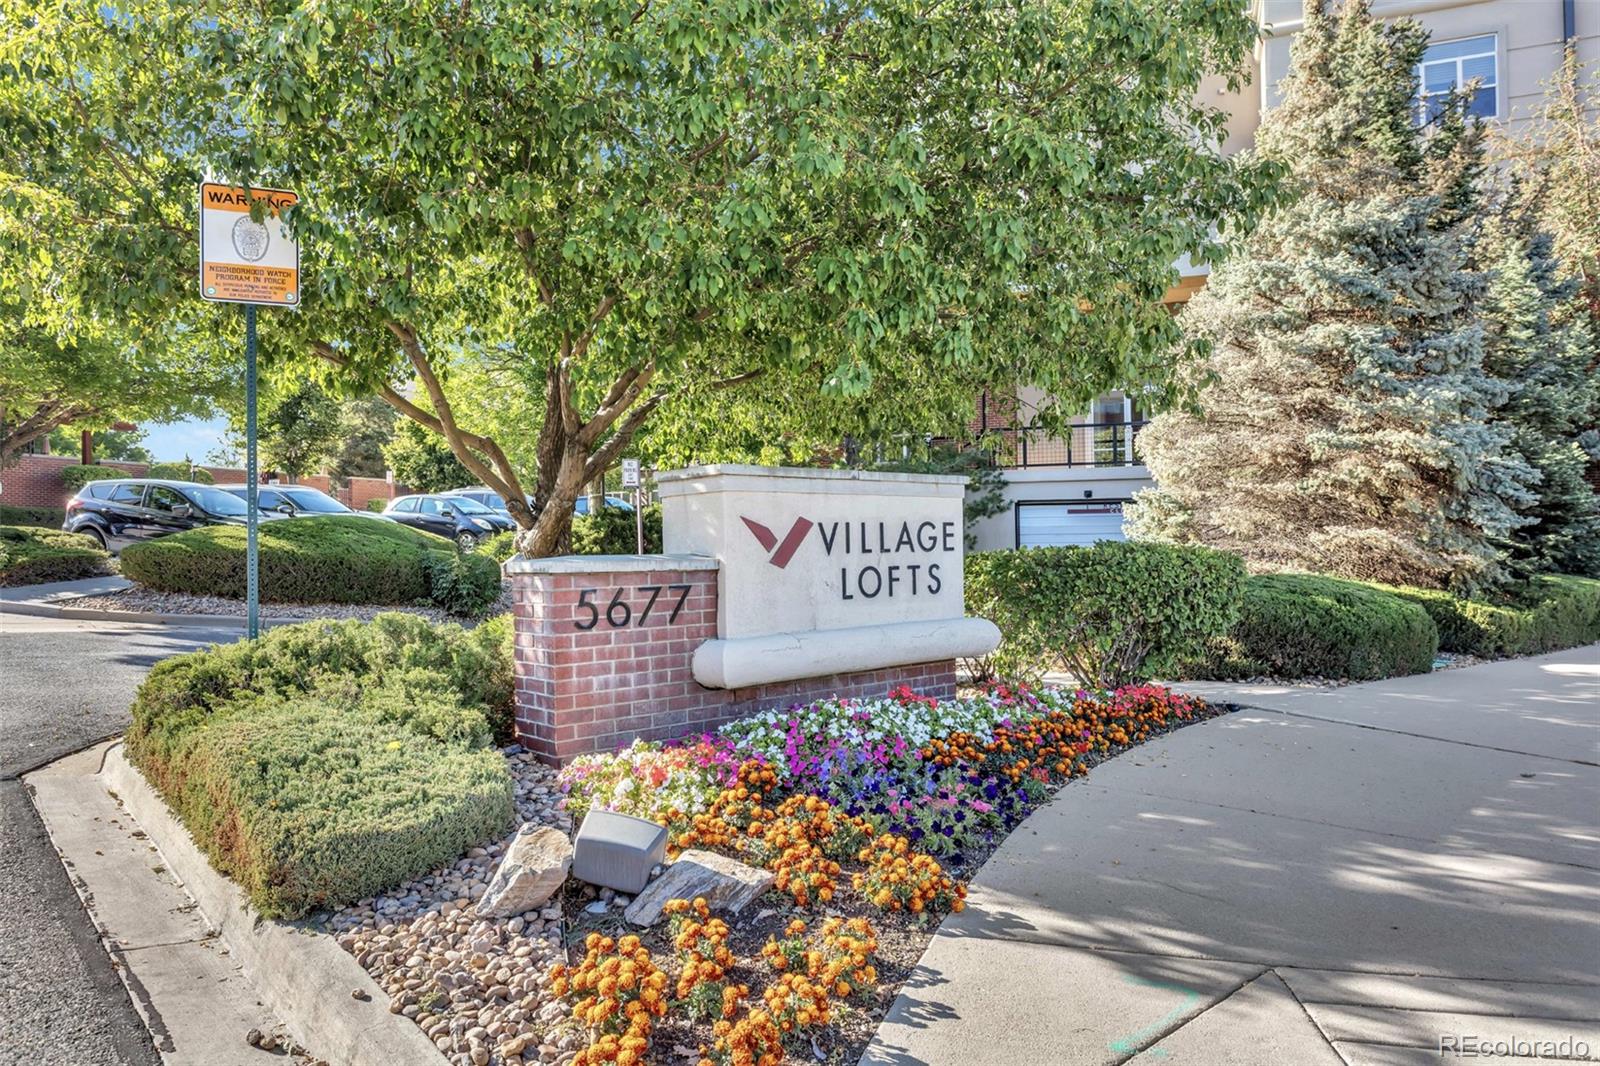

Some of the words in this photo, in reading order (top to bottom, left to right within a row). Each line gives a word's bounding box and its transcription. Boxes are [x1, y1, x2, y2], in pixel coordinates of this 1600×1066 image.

[208, 191, 293, 211] WARNG
[215, 273, 250, 282] PROGRAM
[264, 277, 286, 285] FORCE
[267, 269, 291, 278] WATCH
[818, 521, 955, 556] VILLAGE
[842, 563, 941, 600] LOFTS
[574, 585, 692, 630] 5677
